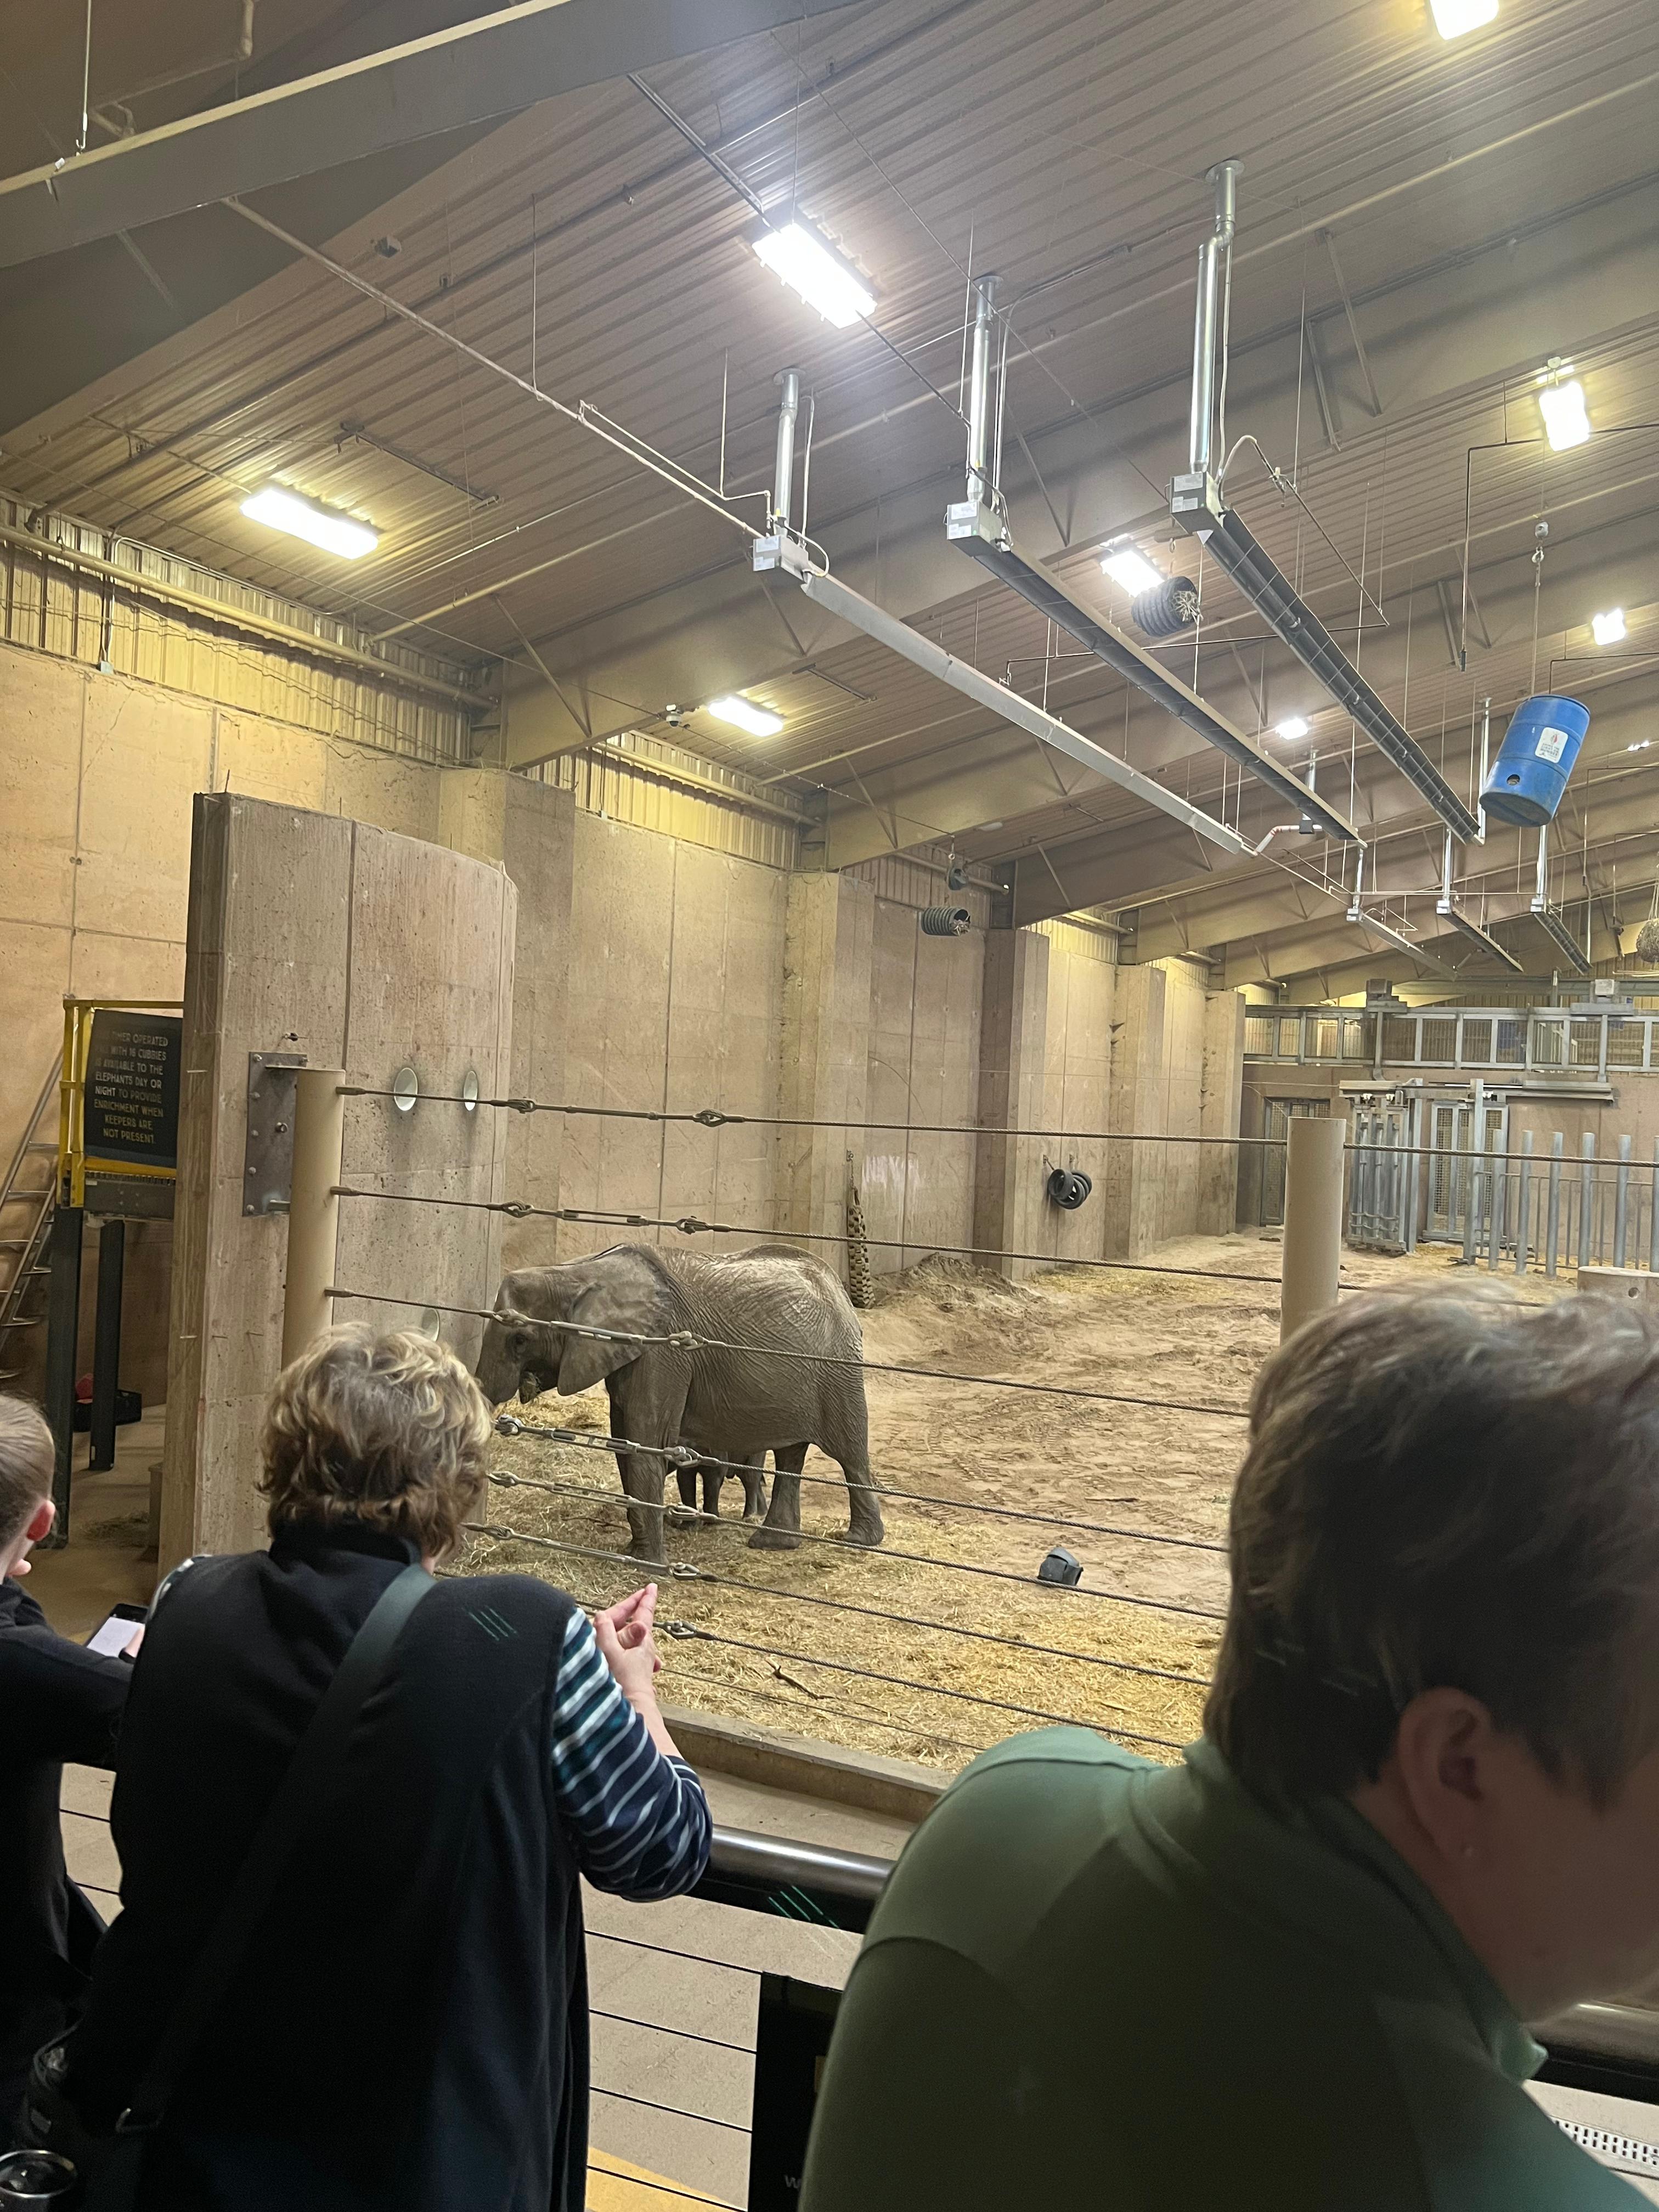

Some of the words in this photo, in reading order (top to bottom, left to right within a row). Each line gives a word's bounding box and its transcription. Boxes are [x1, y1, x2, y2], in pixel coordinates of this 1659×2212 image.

[133, 1033, 168, 1047] OPERATED
[111, 1046, 128, 1056] WITH
[138, 1048, 167, 1061] CUBBIES
[103, 1058, 135, 1071] AVAILABLE
[137, 1063, 146, 1073] TO
[149, 1064, 163, 1075] THE
[95, 1071, 133, 1085] ELEPHANTS
[135, 1076, 149, 1087] DAY
[150, 1079, 162, 1089] OR
[95, 1086, 116, 1097] NIGHT
[119, 1088, 128, 1098] TO
[130, 1090, 162, 1104] PROVIDE
[94, 1098, 139, 1114] ENRICHMENT
[141, 1105, 164, 1118] WHEN
[105, 1114, 137, 1127] KEEPERS
[139, 1119, 154, 1130] ARE
[103, 1128, 119, 1139] NOT
